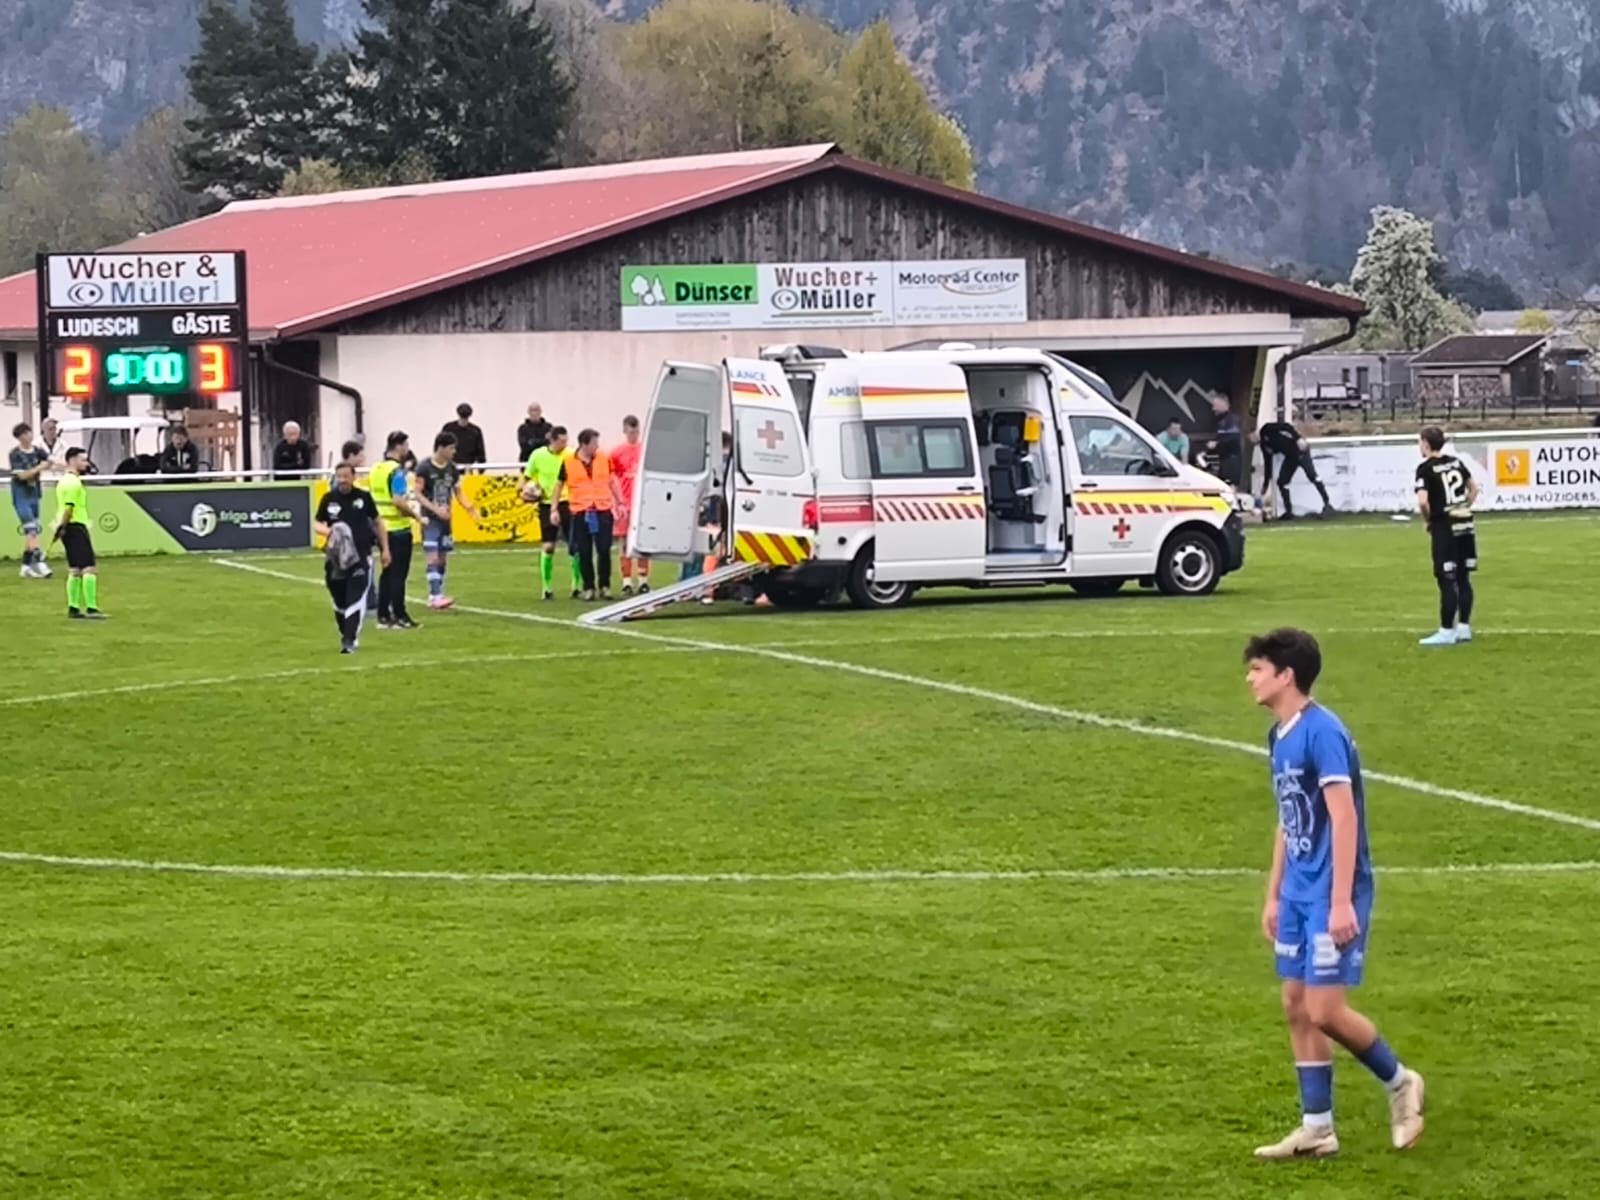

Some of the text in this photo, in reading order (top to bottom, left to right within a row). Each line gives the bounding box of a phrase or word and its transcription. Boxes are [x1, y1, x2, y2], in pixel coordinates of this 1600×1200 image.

[67, 254, 218, 279] Wucher &
[899, 270, 1020, 284] Motorrad Center
[110, 280, 210, 304] Müller
[675, 282, 753, 302] Dünser
[801, 289, 876, 309] Müller
[58, 317, 139, 337] LUDESCH
[172, 312, 231, 335] GÄSTE
[65, 347, 92, 393] 2
[199, 344, 225, 391] 3
[1441, 469, 1467, 505] 12
